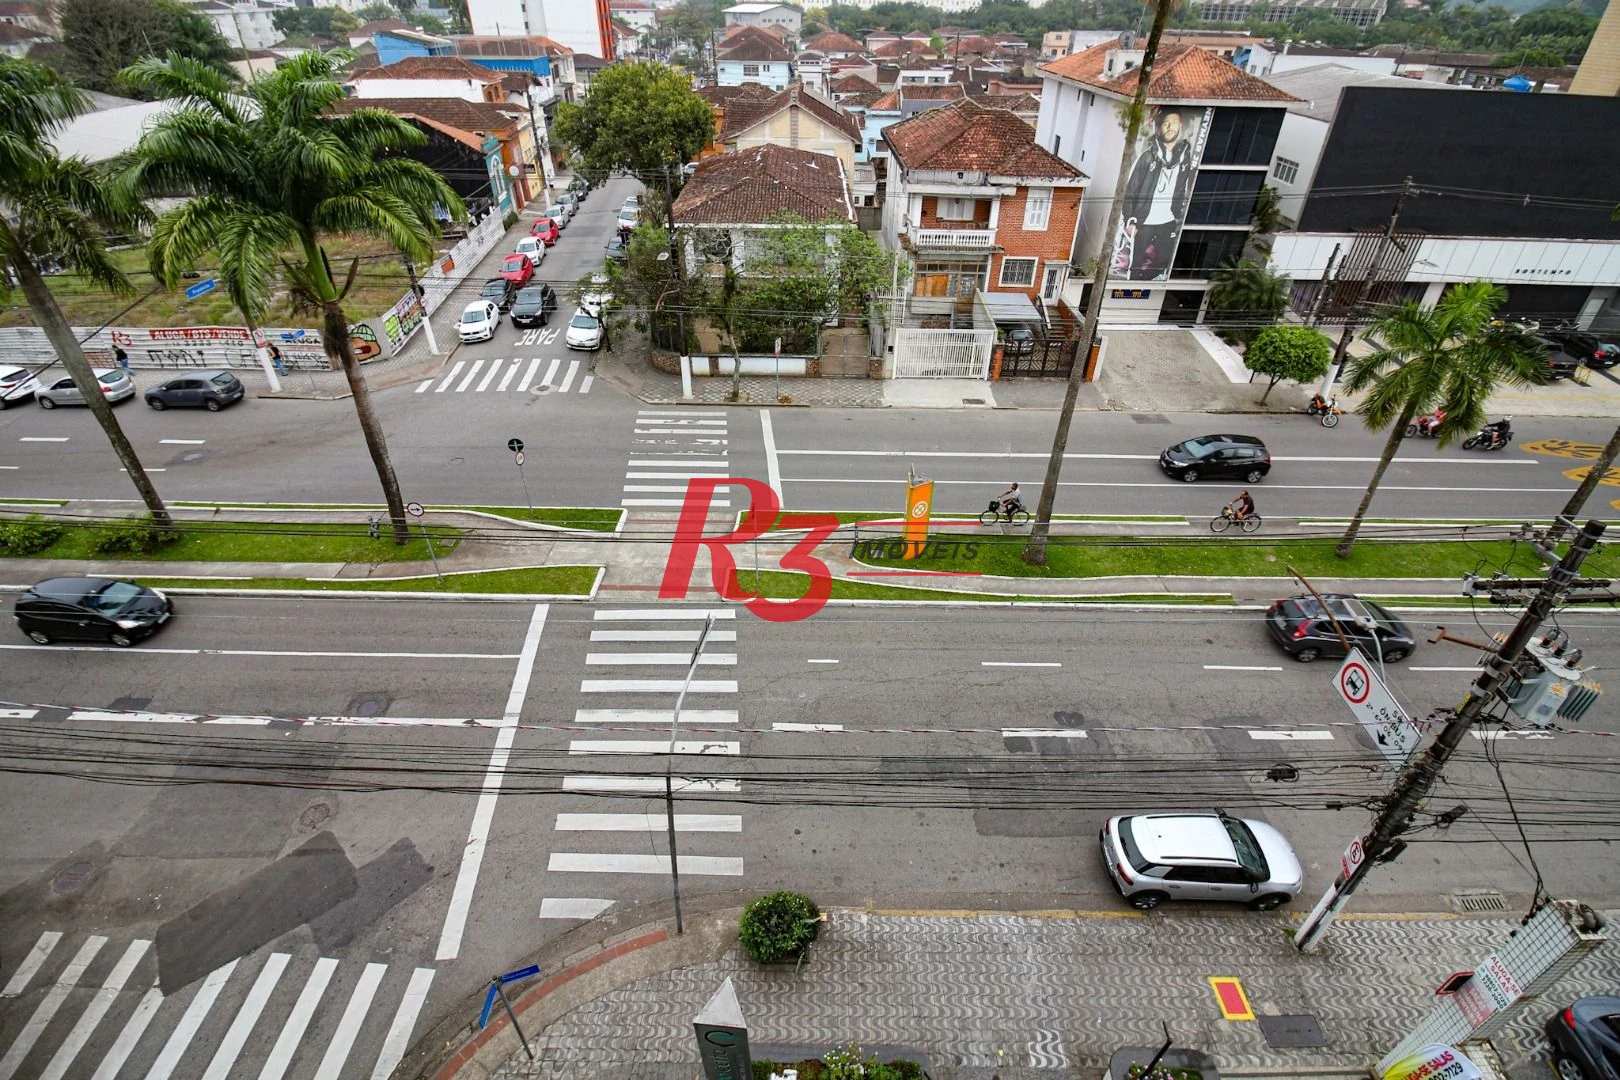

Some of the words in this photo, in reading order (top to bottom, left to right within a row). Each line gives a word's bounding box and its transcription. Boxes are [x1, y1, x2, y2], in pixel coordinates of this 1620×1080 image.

[1195, 106, 1213, 152] NEYMAR
[513, 328, 561, 346] PARE
[1490, 956, 1521, 997] ALUGA-SE
[1490, 965, 1511, 994] SALAS
[1427, 1050, 1455, 1071] SALAS
